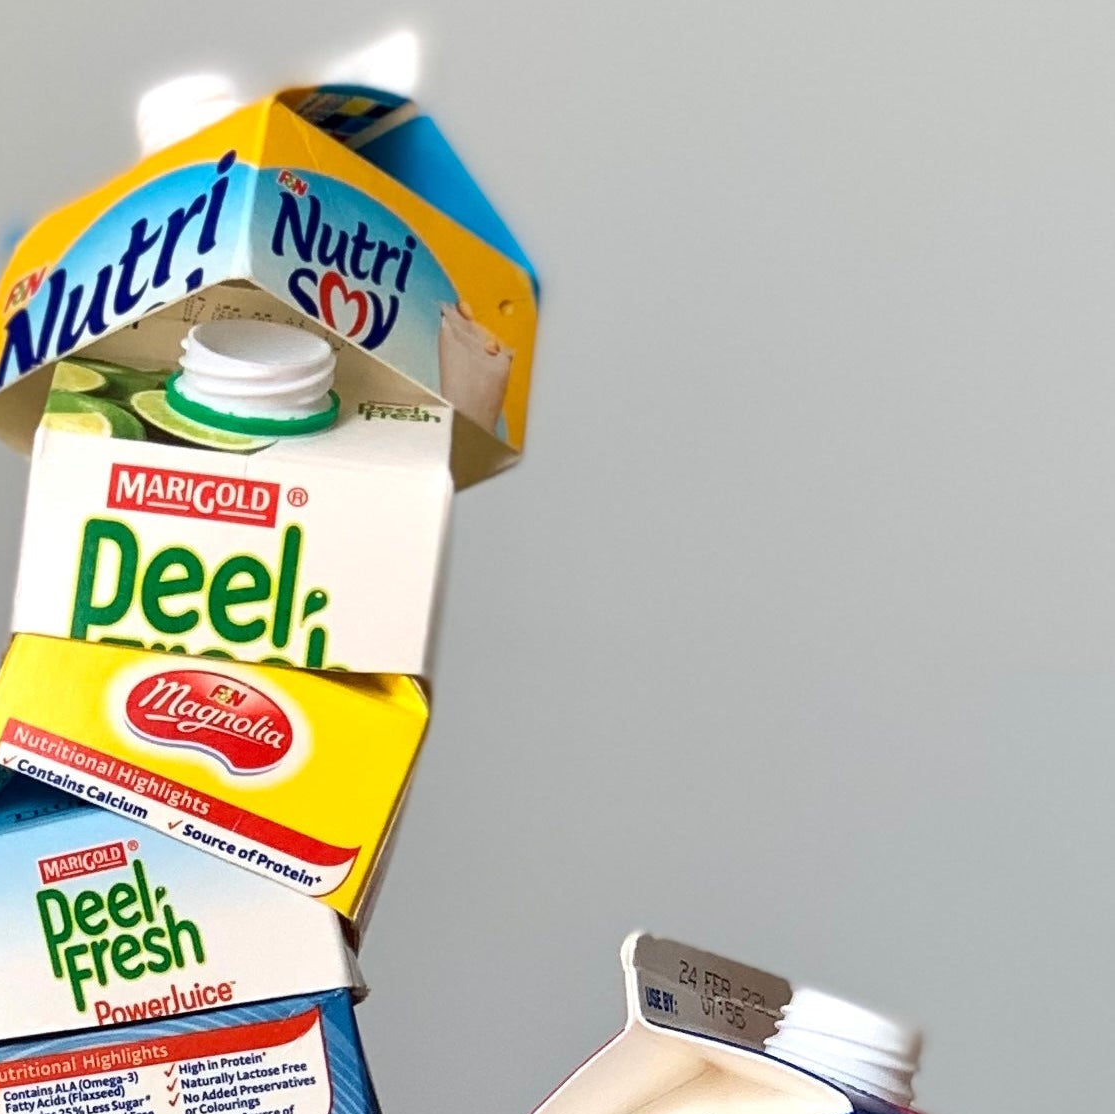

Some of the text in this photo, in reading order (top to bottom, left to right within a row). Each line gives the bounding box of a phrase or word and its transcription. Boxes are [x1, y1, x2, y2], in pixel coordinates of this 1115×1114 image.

[272, 191, 417, 292] Nutri
[70, 517, 302, 648] Peel
[137, 677, 285, 748] Magnolia
[13, 726, 116, 776] Nutritional
[116, 765, 211, 816] Highlights
[17, 758, 85, 794] Contains
[86, 785, 149, 820] Calcium
[182, 823, 236, 854] Source
[237, 848, 257, 862] of
[36, 859, 154, 978] Peel
[64, 904, 205, 1012] Fresh
[678, 959, 697, 990] 24
[704, 971, 732, 999] FEB
[644, 985, 663, 1010] USE
[84, 1045, 168, 1070] Highlights
[178, 1059, 218, 1075] High in
[3, 1071, 138, 1104] Contains ALA (Omega-3)
[181, 1063, 307, 1089] Naturally Lactose Free
[183, 1076, 315, 1104] No Added Preservatives
[5, 1085, 125, 1113] Fatty Acids (Flaxseed)
[86, 1103, 110, 1114] Less
[199, 1098, 260, 1114] Colourings
